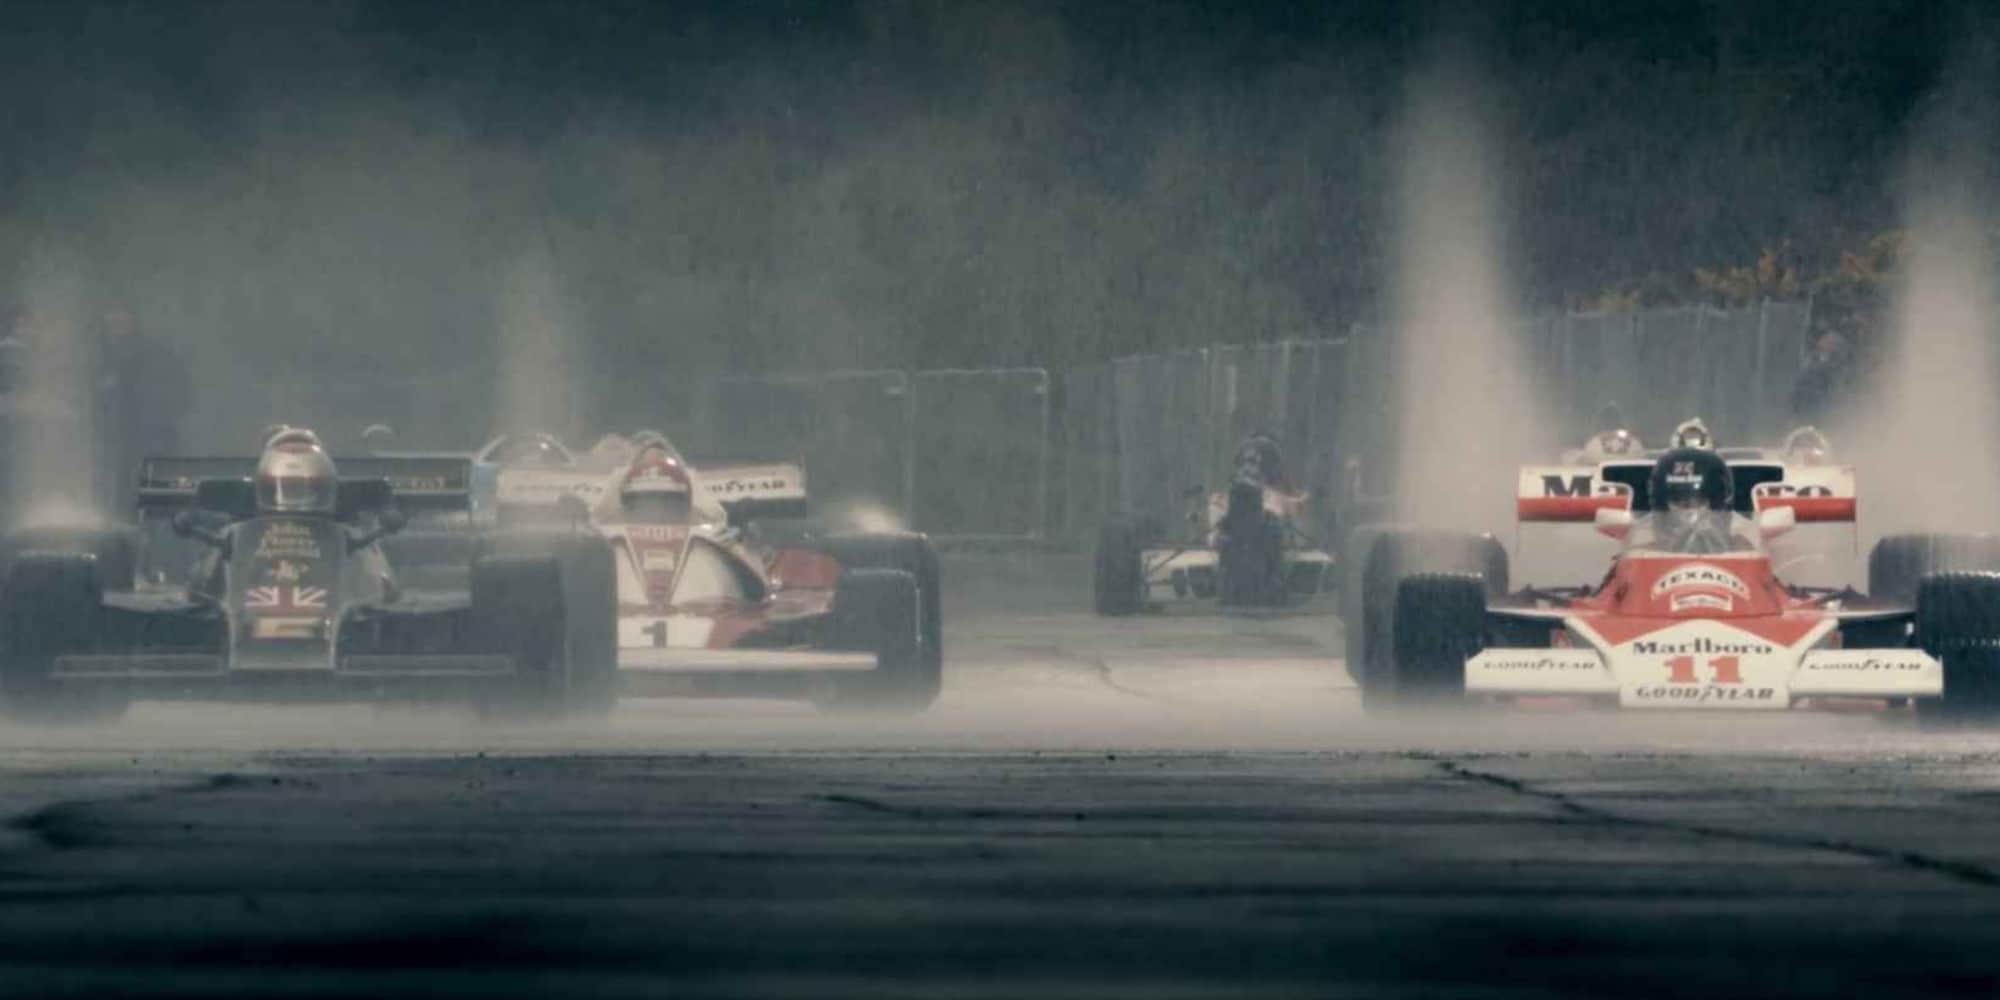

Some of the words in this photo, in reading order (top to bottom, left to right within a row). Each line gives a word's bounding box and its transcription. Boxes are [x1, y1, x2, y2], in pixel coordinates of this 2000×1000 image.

[1656, 570, 1746, 593] TEXACO
[642, 621, 668, 648] 1
[1633, 637, 1773, 654] Marlboro
[1664, 655, 1745, 684] 11
